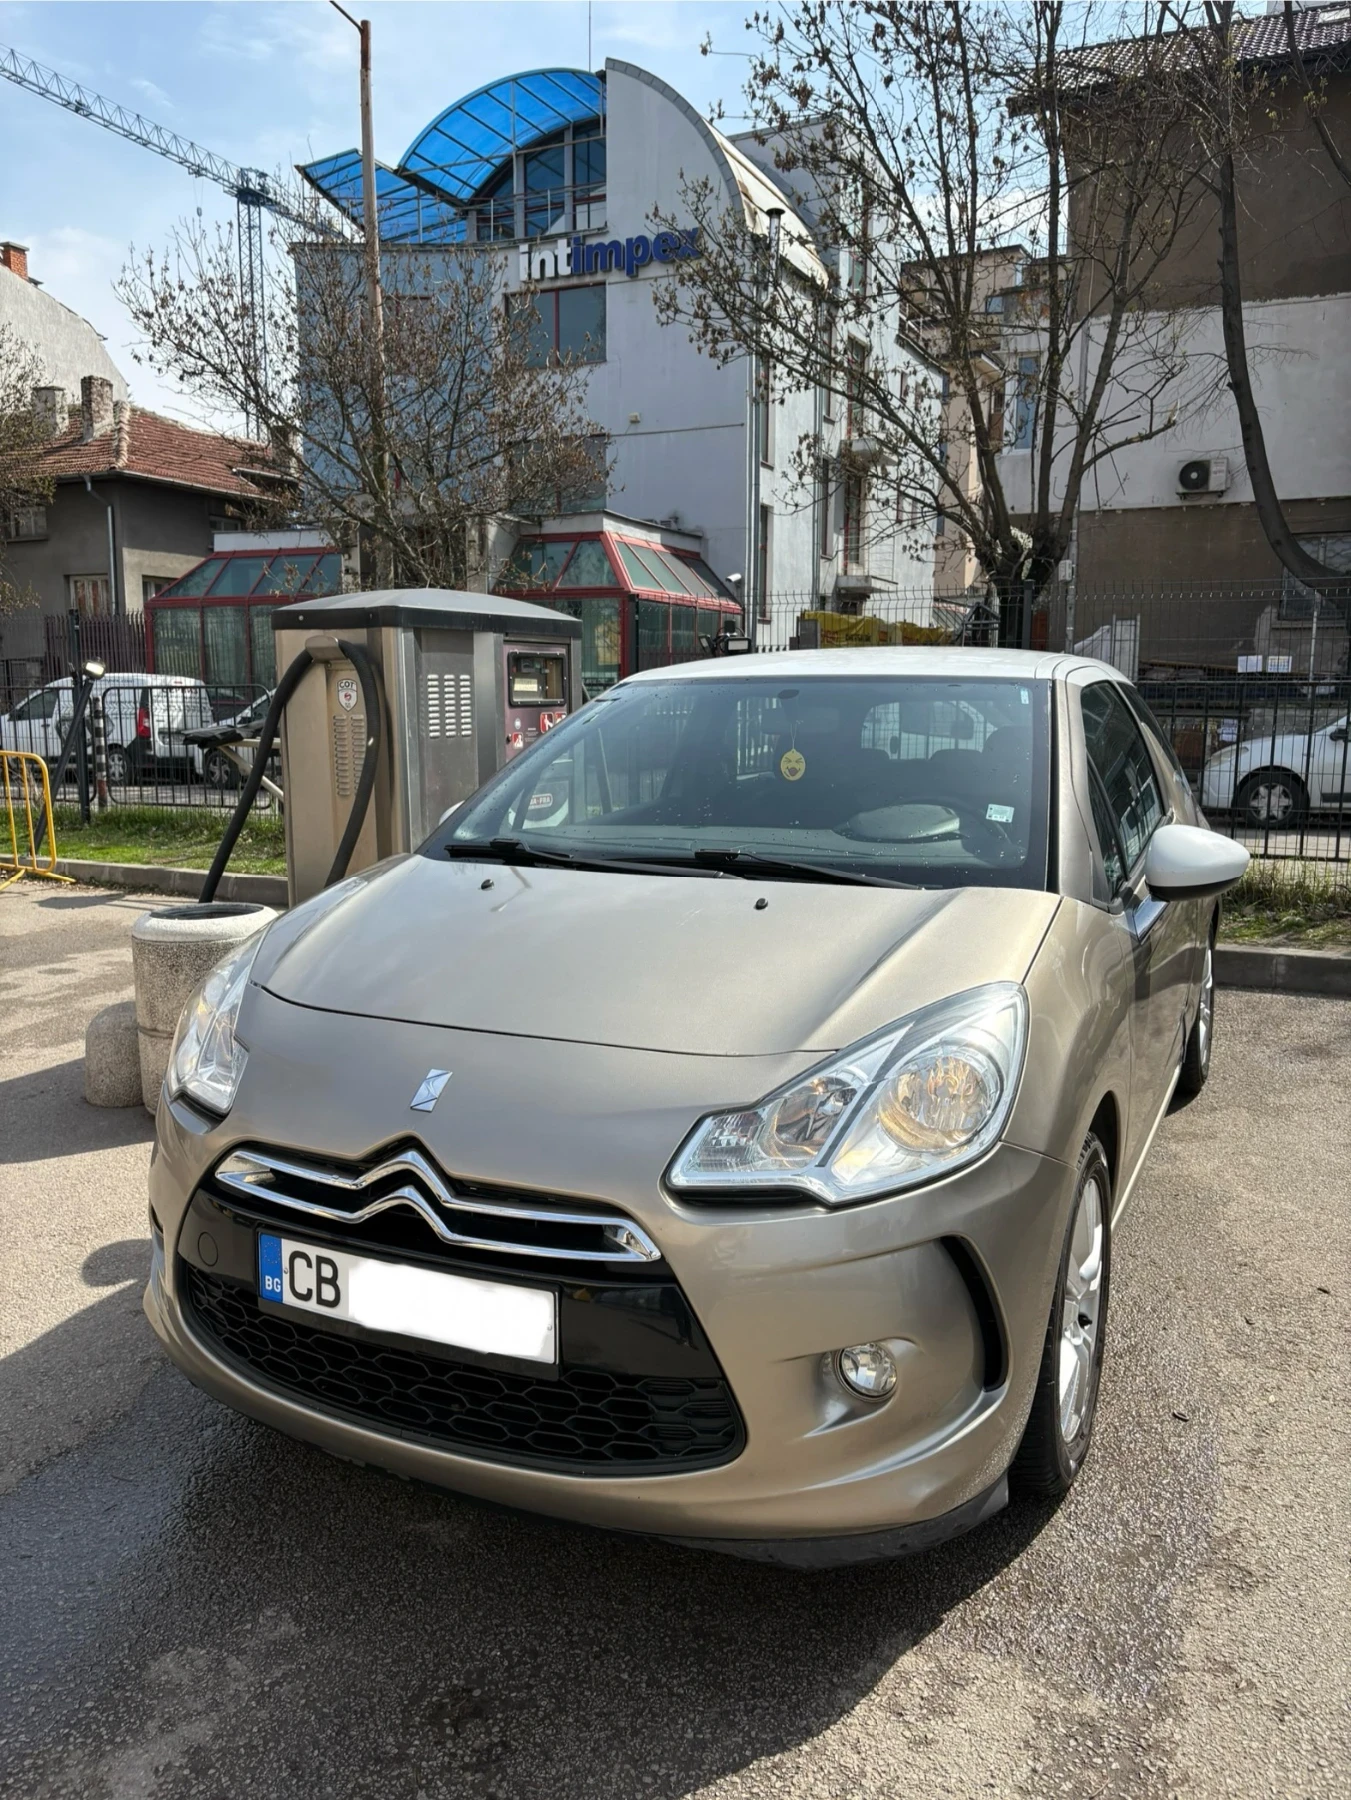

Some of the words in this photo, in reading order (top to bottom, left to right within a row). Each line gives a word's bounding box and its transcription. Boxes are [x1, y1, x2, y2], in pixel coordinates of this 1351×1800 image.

[519, 226, 701, 281] intimpex
[265, 1275, 281, 1293] BG
[288, 1250, 341, 1309] CB
